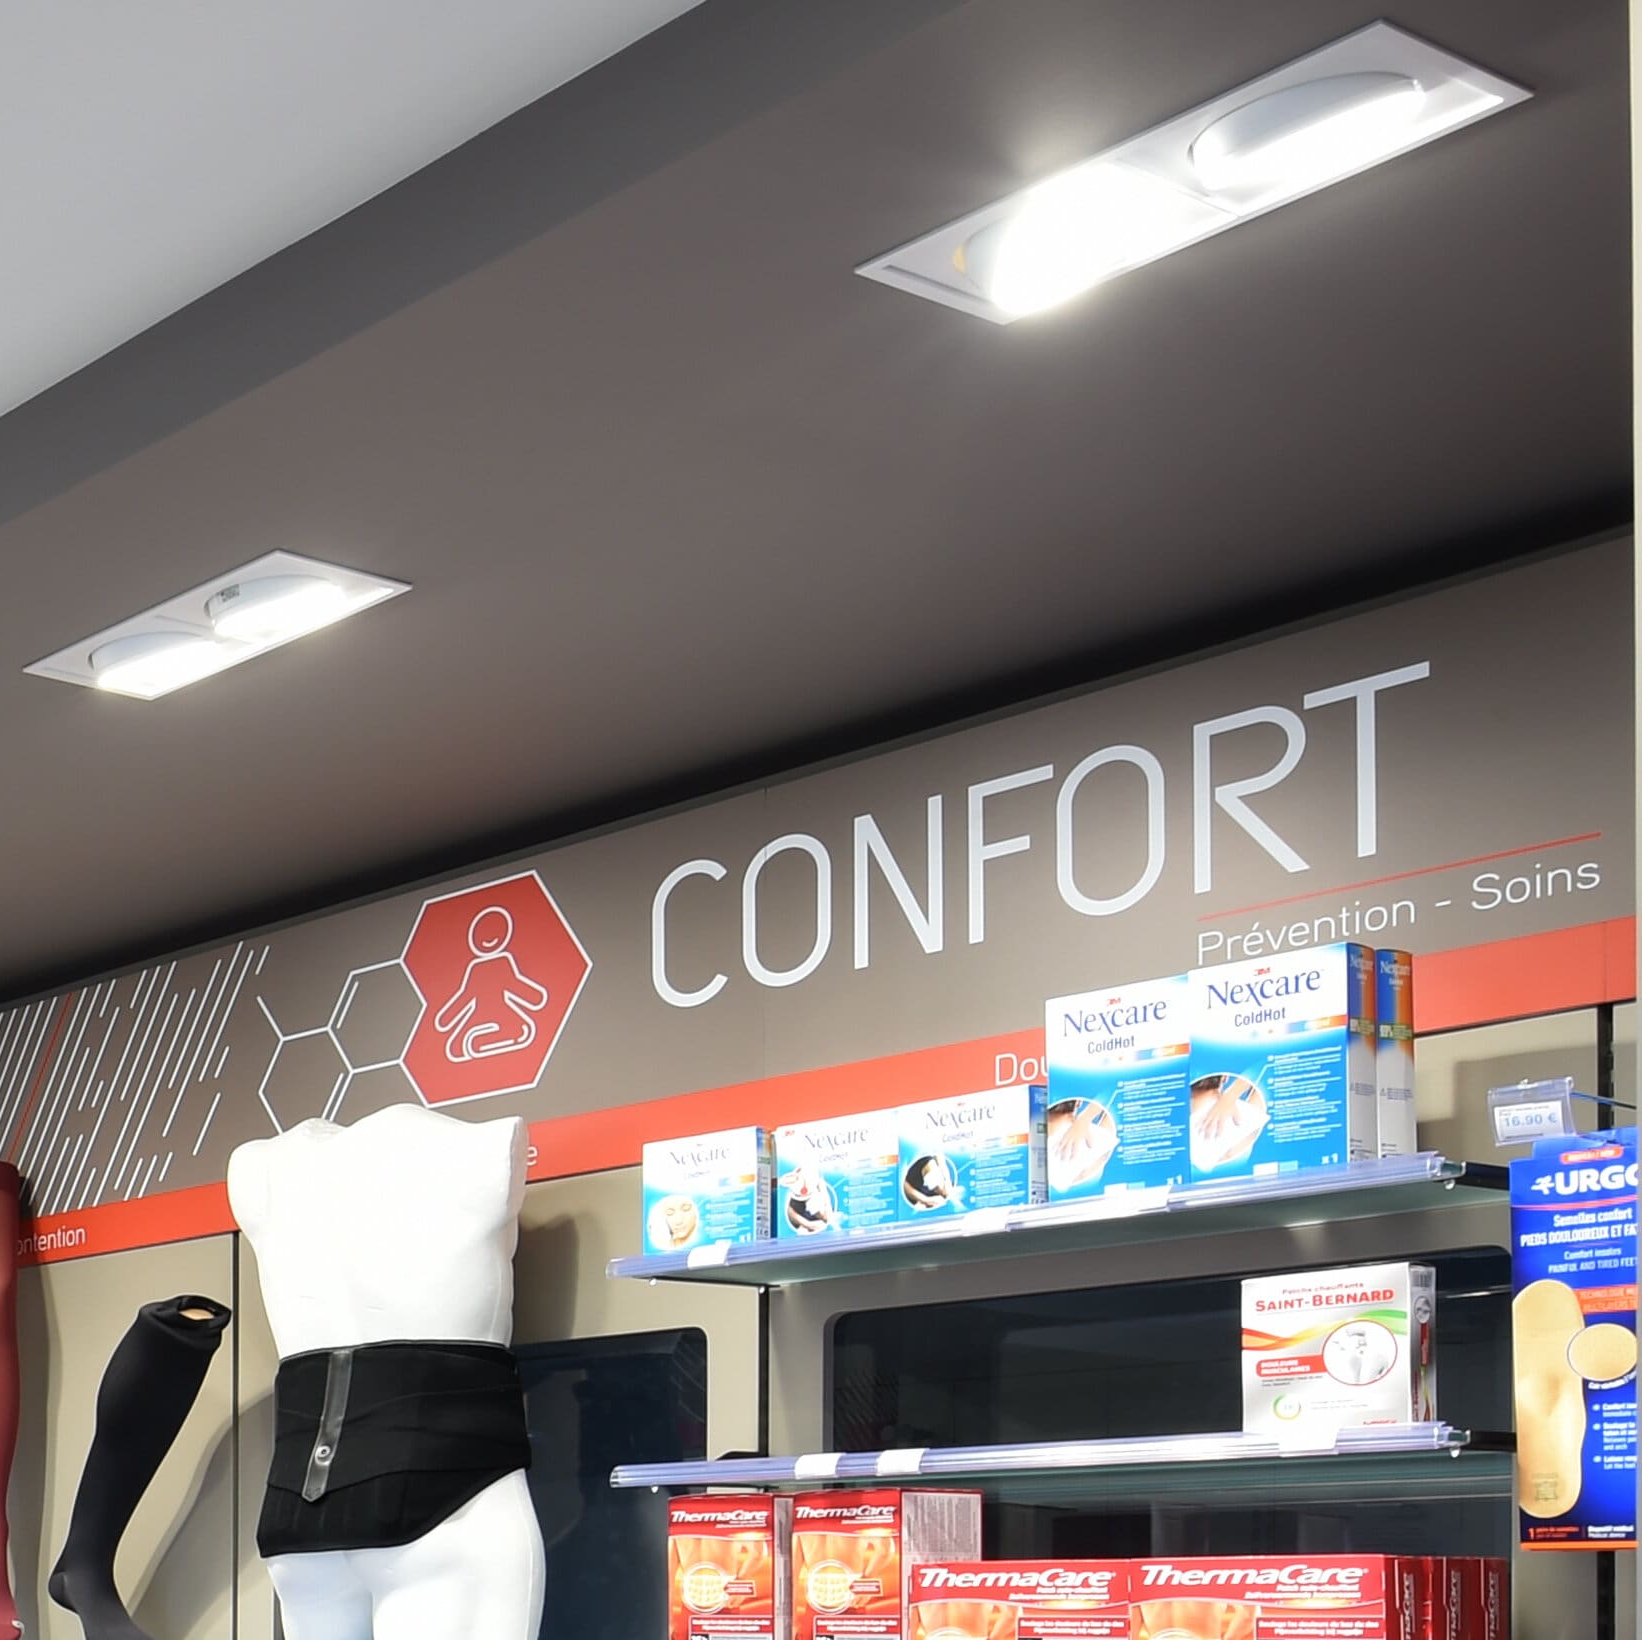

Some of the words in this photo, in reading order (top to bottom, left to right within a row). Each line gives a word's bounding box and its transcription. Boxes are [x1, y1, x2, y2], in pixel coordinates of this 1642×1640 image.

[652, 661, 1429, 1007] CONFORT
[1196, 896, 1417, 965] Prévention
[1472, 857, 1601, 908] Soins
[1206, 970, 1321, 1009] Nexcare
[1063, 1001, 1167, 1038] Nexcare
[1234, 1008, 1286, 1027] ColdHot
[1088, 1036, 1135, 1054] ColdHot
[1504, 1115, 1543, 1127] 16.90
[1548, 1114, 1557, 1123] €
[1256, 1289, 1394, 1312] SAINT-BERNARD
[671, 1509, 769, 1524] ThermaCare
[796, 1506, 897, 1521] ThermaCare
[919, 1568, 1114, 1589] ThermaCare
[1140, 1564, 1364, 1586] ThermaCare
